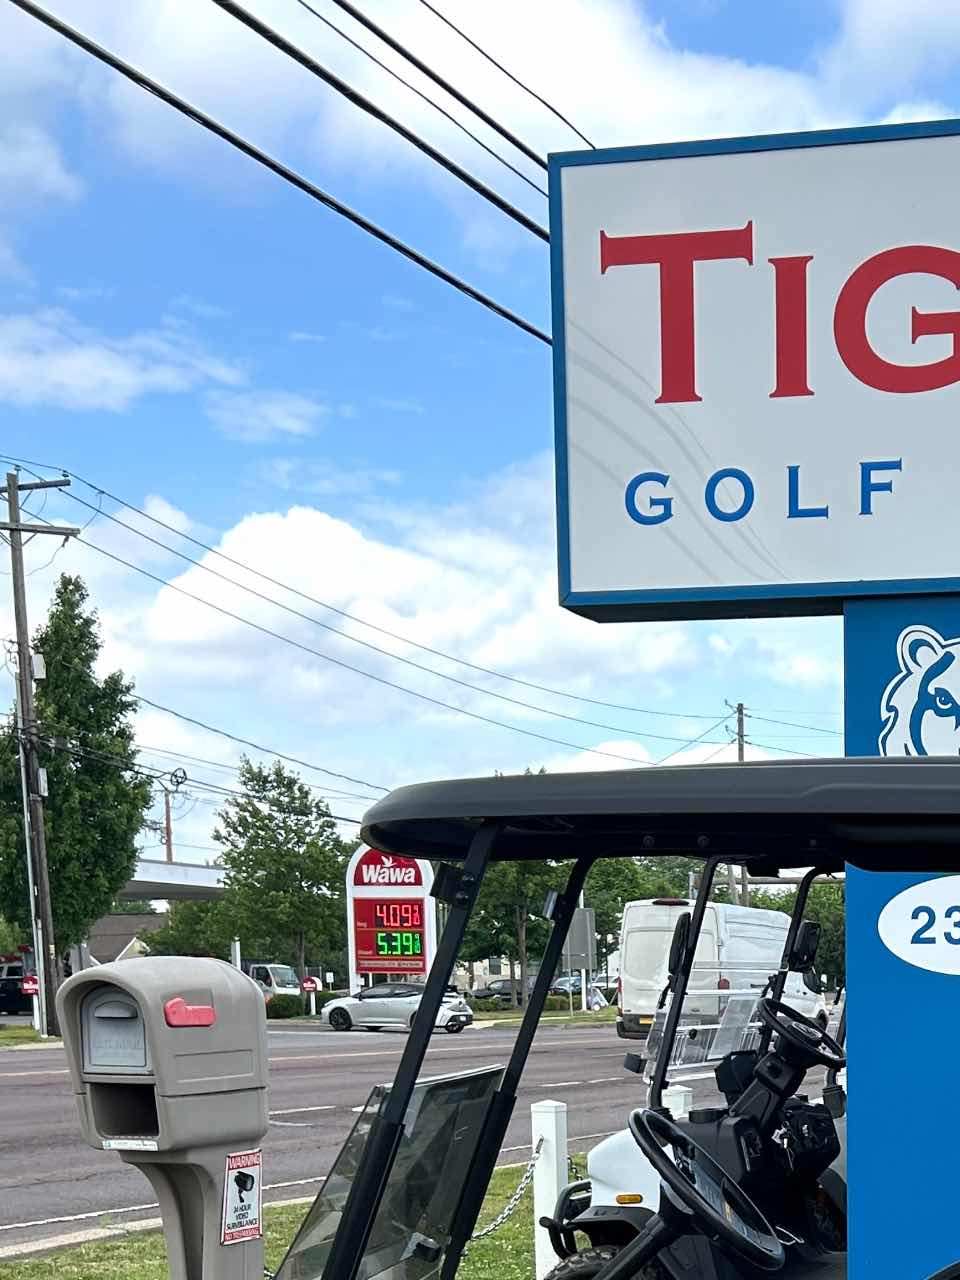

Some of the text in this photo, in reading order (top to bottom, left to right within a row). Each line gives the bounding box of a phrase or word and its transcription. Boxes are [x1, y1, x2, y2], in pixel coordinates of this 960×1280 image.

[624, 460, 903, 526] GOLF
[362, 864, 415, 883] Wawa
[376, 904, 412, 927] 4.09
[377, 932, 413, 955] 5.39
[229, 1153, 260, 1169] WARNING
